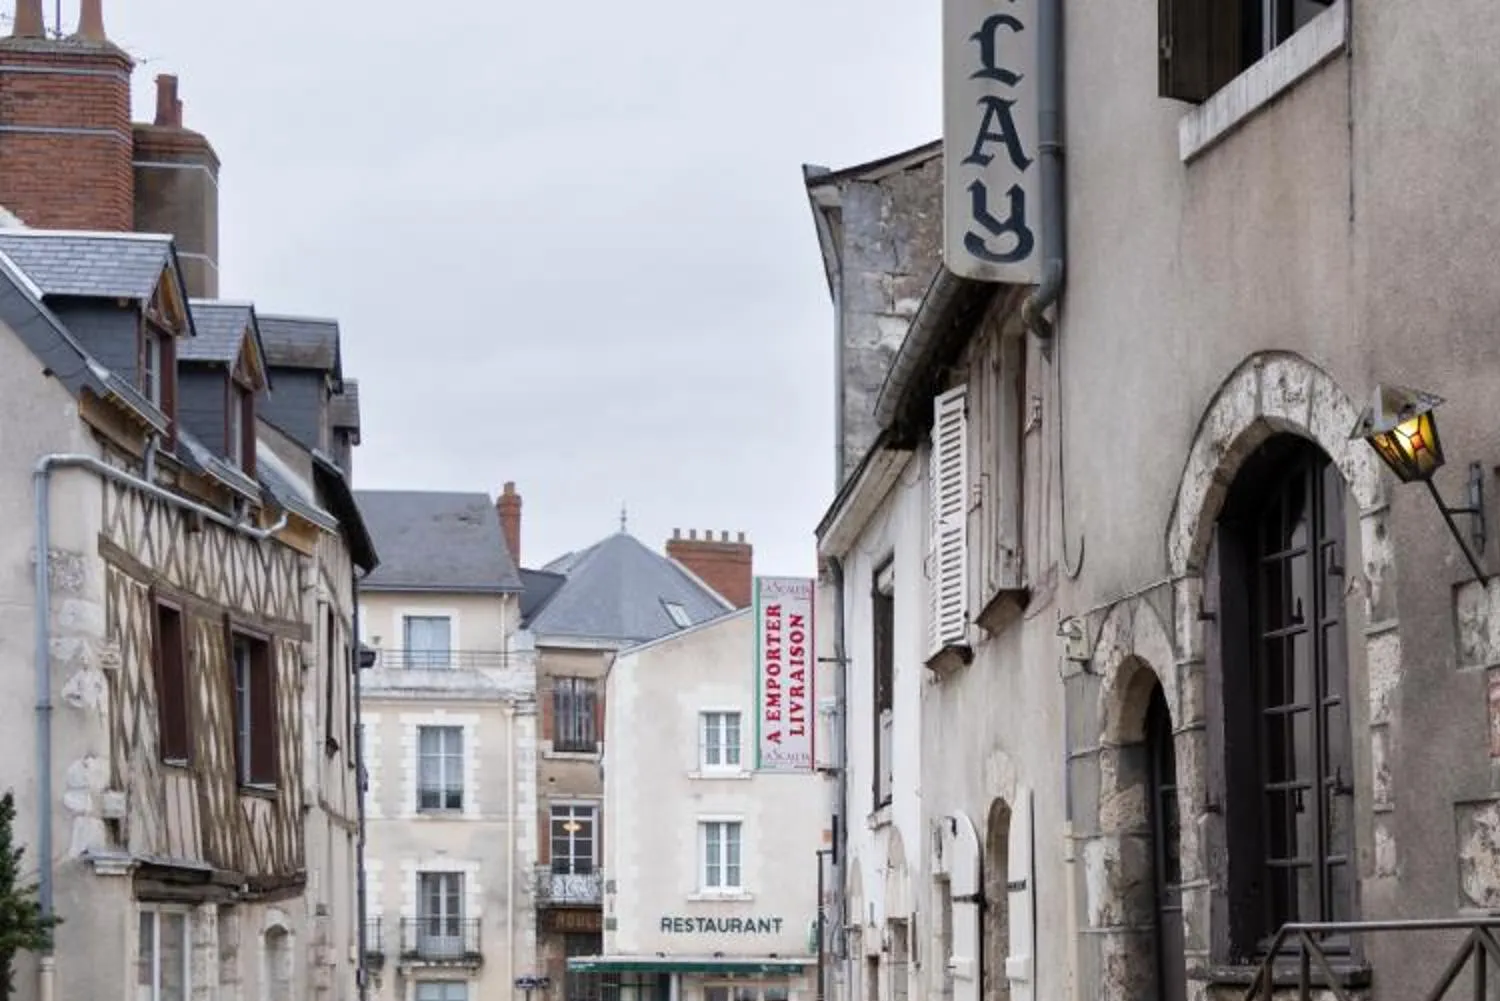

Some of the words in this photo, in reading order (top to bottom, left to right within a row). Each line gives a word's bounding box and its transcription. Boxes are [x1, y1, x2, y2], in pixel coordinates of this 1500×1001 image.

[961, 0, 1034, 263] LAY
[766, 604, 782, 721] EMPORTER
[789, 614, 805, 737] LIVRAISON
[766, 730, 782, 744] A
[660, 917, 783, 934] RESTAURANT
